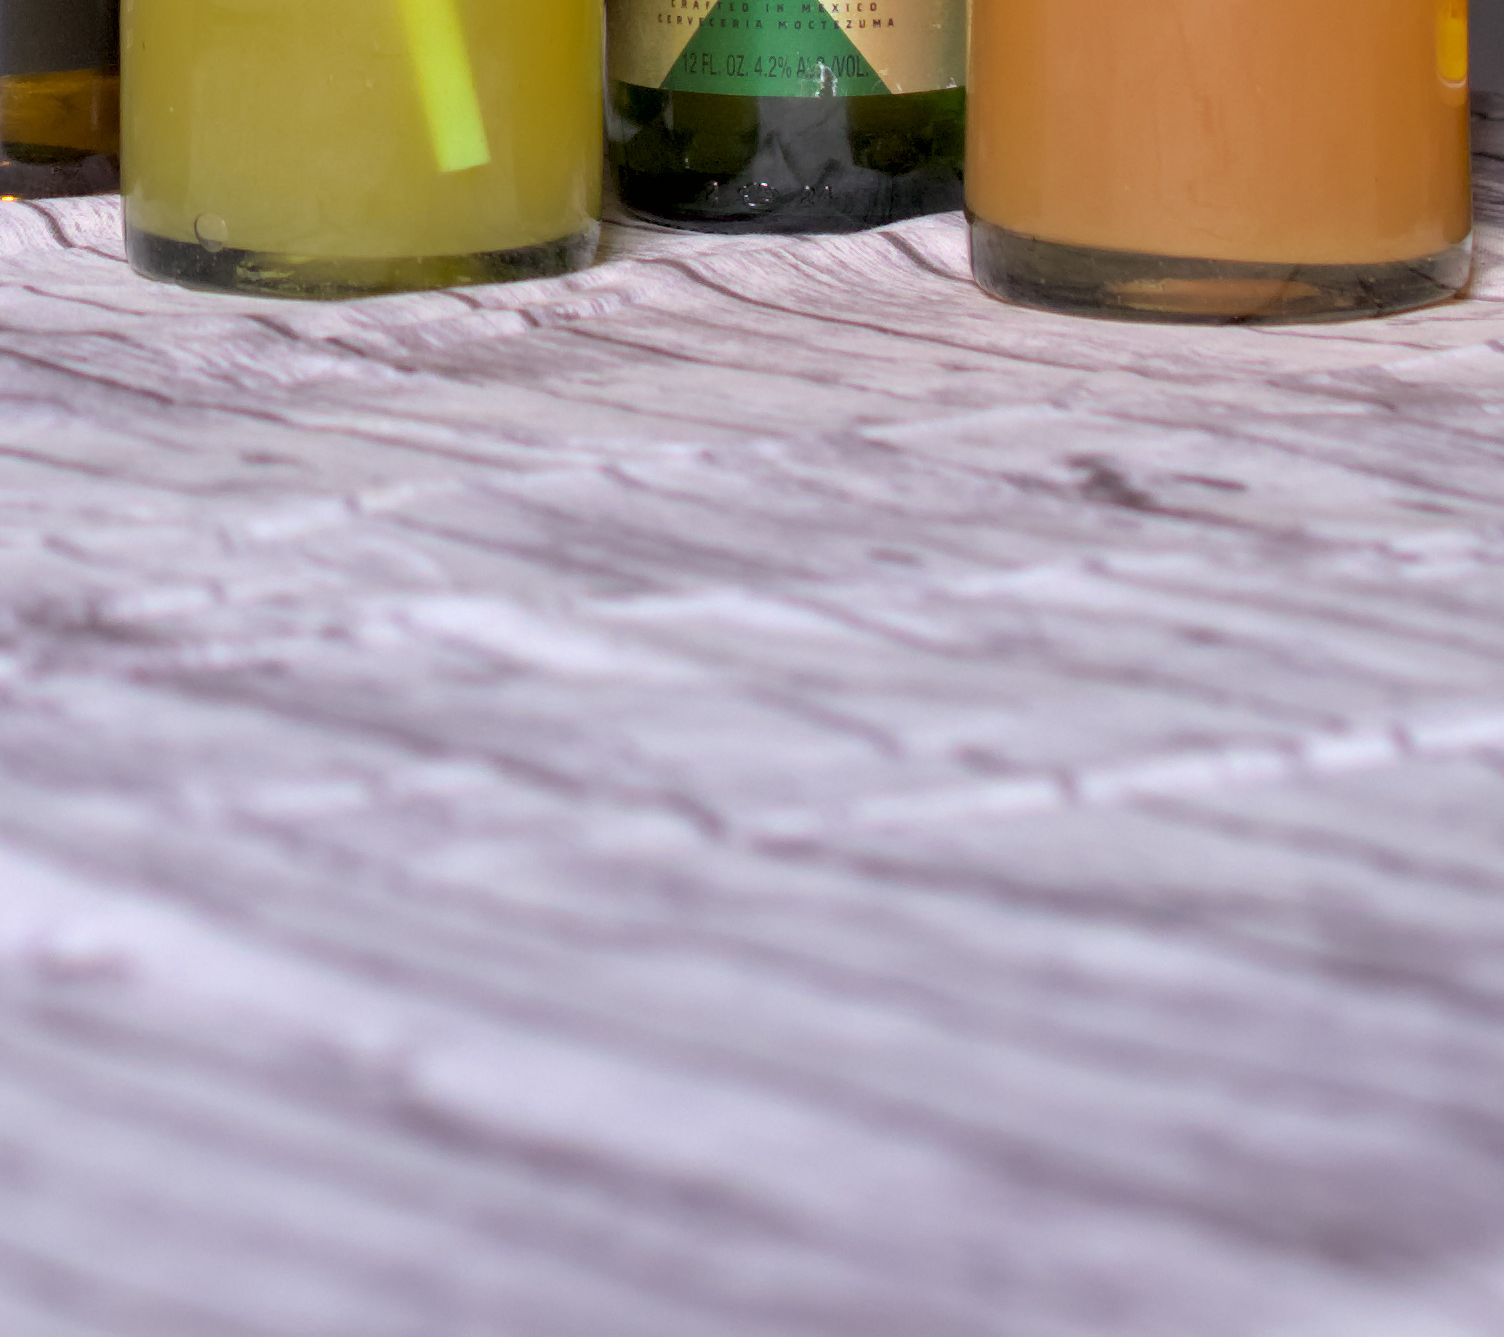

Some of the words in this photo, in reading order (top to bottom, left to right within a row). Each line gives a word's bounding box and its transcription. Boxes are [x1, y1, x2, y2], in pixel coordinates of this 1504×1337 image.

[765, 2, 785, 13] IN
[801, 2, 878, 14] MEXICO
[657, 13, 764, 30] CERVECERIA
[777, 17, 895, 30] MOCTEZUMA
[682, 54, 698, 75] 12
[726, 54, 749, 77] OZ.
[754, 56, 793, 79] 4.2%
